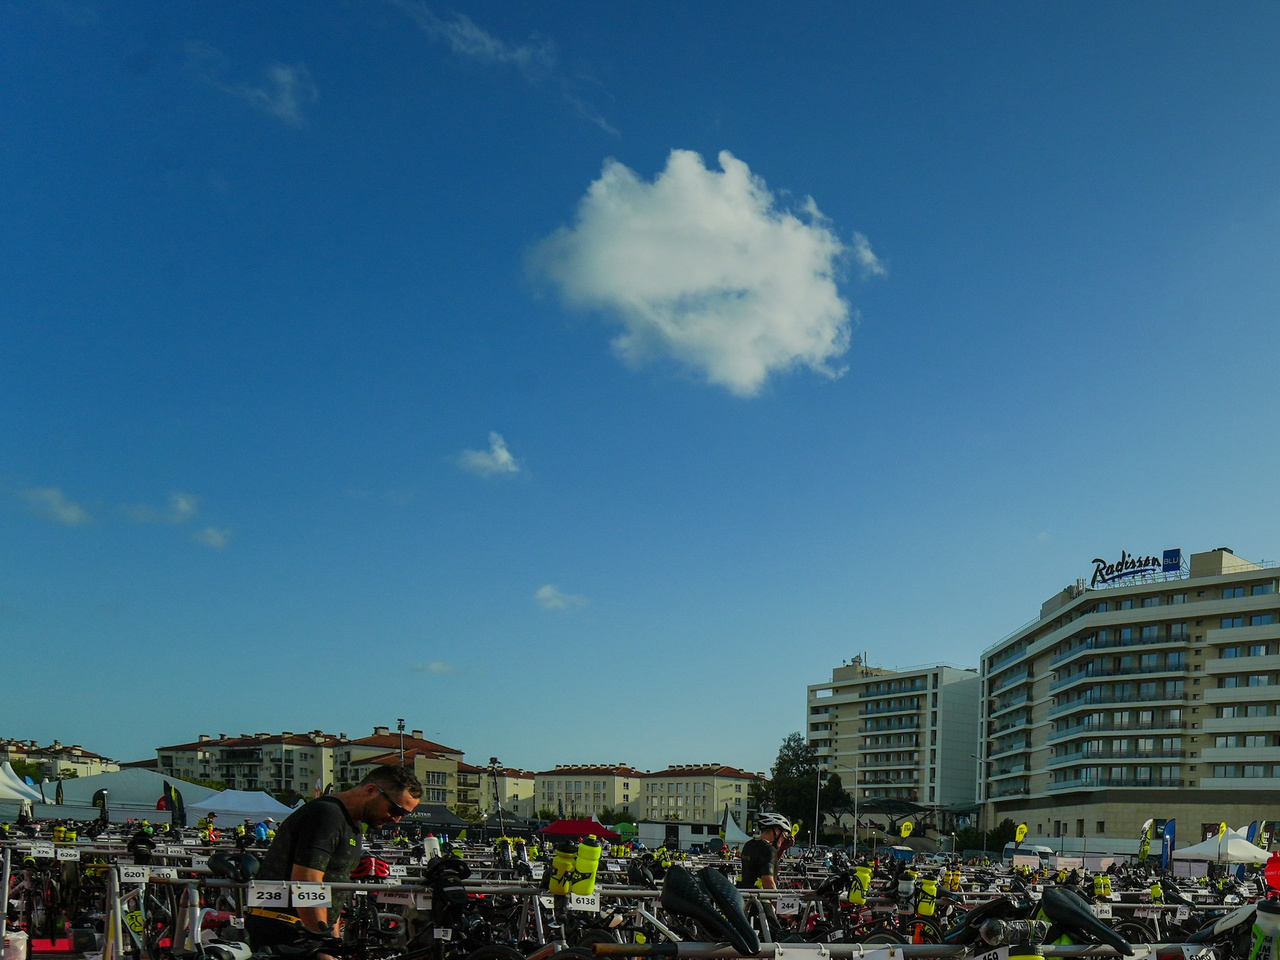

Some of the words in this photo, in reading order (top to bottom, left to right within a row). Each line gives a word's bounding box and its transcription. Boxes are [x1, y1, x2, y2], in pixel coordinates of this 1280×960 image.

[1091, 550, 1162, 588] Radisson
[1163, 557, 1179, 566] BLU
[256, 891, 282, 900] 238
[297, 891, 326, 901] 6136
[576, 897, 596, 906] 6138
